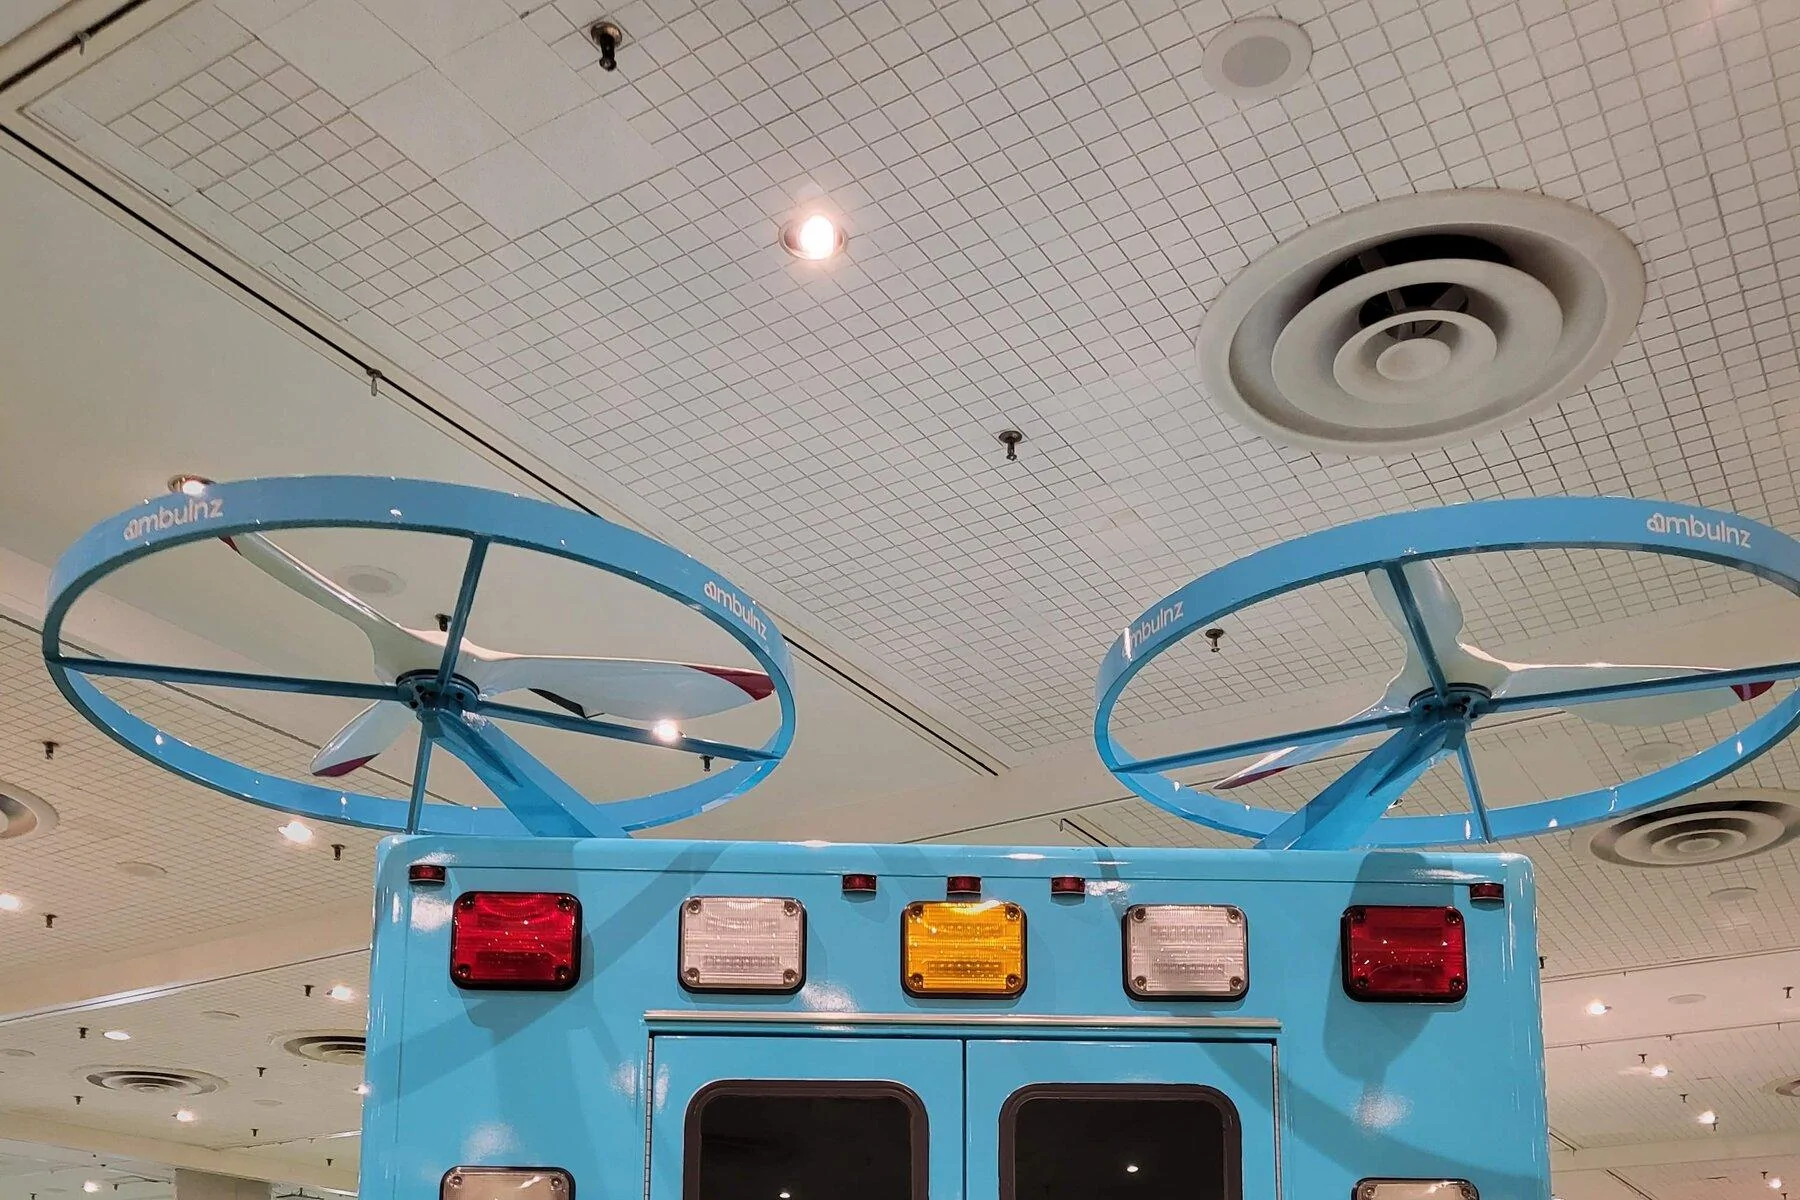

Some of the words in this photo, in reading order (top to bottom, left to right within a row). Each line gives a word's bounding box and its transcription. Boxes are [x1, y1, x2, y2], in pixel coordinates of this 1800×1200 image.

[123, 499, 224, 540] ambulnz
[1646, 512, 1752, 549] ambulnz
[703, 581, 767, 640] ambulnz
[1122, 601, 1184, 660] mbulnz
